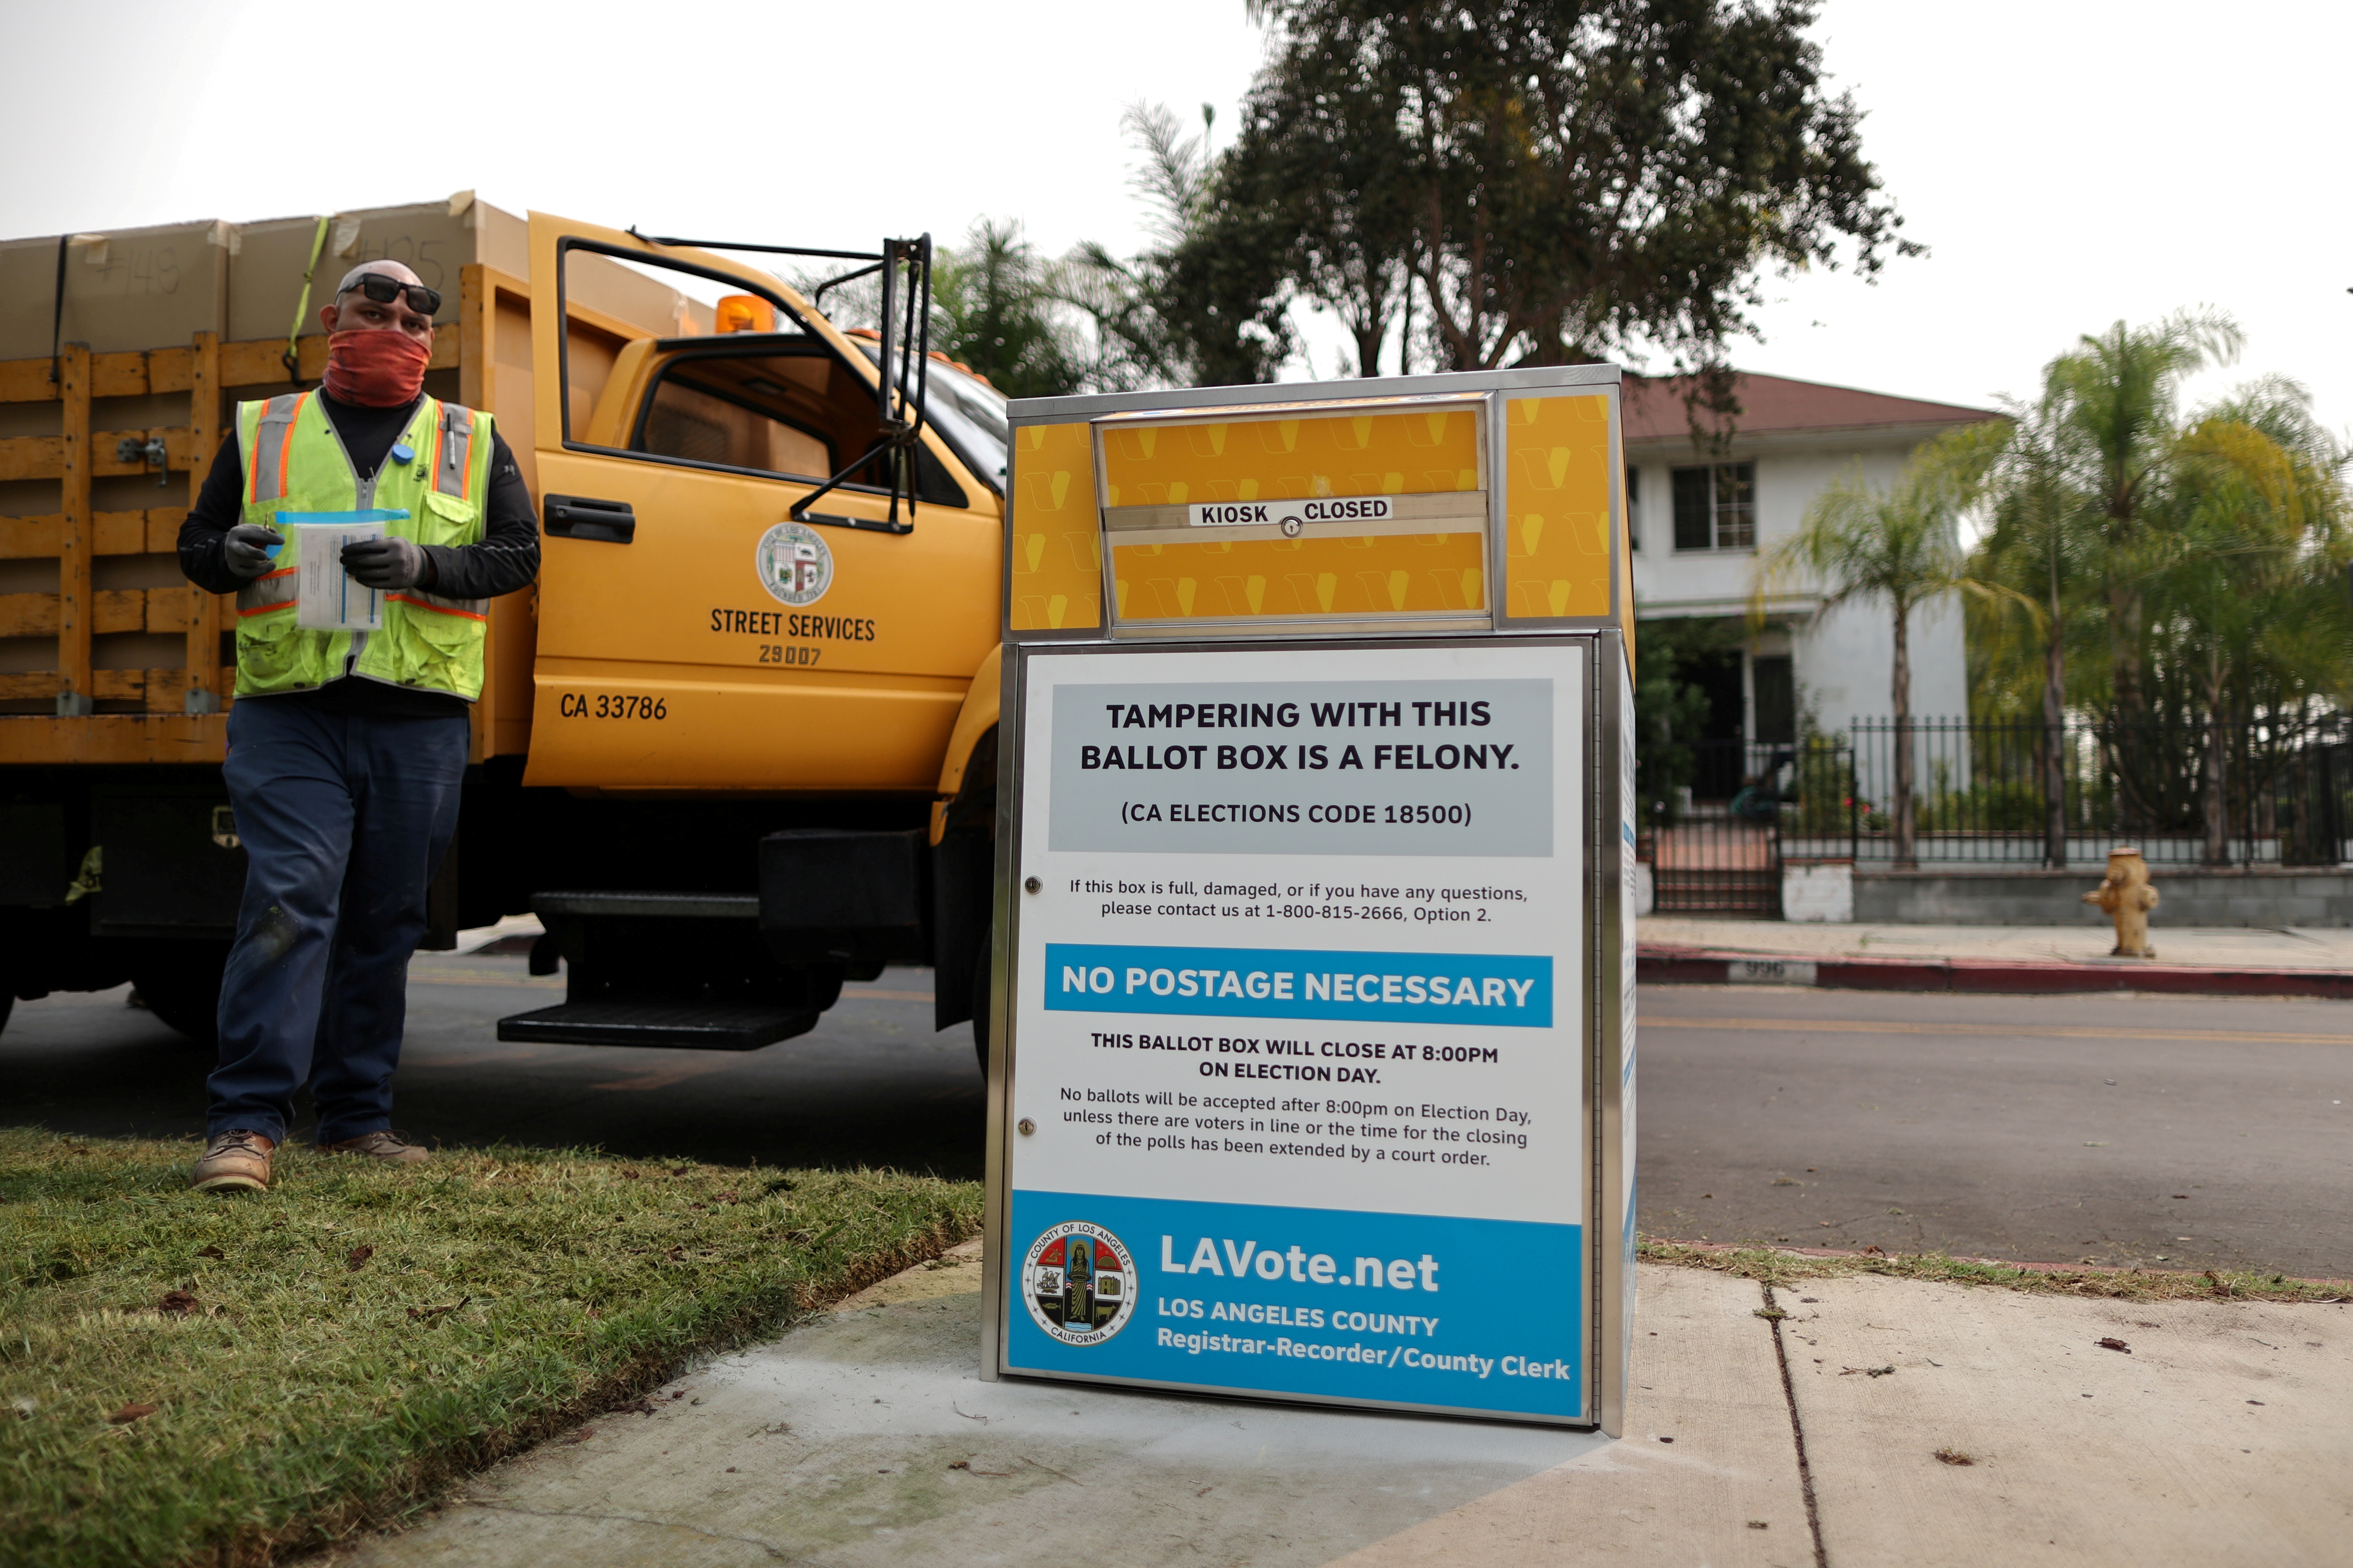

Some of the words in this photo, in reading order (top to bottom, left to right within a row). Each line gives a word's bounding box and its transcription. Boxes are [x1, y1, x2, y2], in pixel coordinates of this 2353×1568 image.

[1202, 506, 1269, 523] KIOSK
[1305, 500, 1388, 520] CLOSED
[711, 608, 782, 635] STREET
[788, 614, 875, 641] SERVICES
[759, 644, 821, 666] 29007
[561, 693, 588, 718] CA
[595, 694, 667, 720] 33786
[1106, 703, 1300, 728] TAMPERING
[1310, 702, 1401, 727] WITH
[1412, 701, 1491, 726] THIS
[1082, 745, 1207, 770] BALLOT
[1217, 745, 1288, 770] BOX
[1299, 745, 1328, 770] IS
[1338, 745, 1364, 769] A
[1374, 744, 1519, 769] FELONY.
[1122, 801, 1162, 824] (CA
[1170, 804, 1300, 823] ELECTIONS
[1309, 804, 1375, 823] CODE
[1384, 803, 1471, 827] 18500)
[1071, 879, 1081, 892] If
[1085, 879, 1113, 893] this
[1119, 880, 1146, 893] box
[1152, 881, 1163, 894] is
[1168, 881, 1198, 897] full,
[1204, 882, 1281, 900] damaged,
[1287, 886, 1304, 897] or
[1310, 883, 1320, 897] if
[1325, 887, 1354, 901] you
[1361, 884, 1399, 898] have
[1405, 888, 1435, 902] any
[1441, 886, 1527, 903] questions,
[1102, 901, 1152, 917] please
[1157, 903, 1216, 916] contact
[1222, 907, 1239, 917] us
[1245, 905, 1260, 917] at
[1266, 904, 1407, 922] 1-800-815-2666,
[1414, 907, 1470, 924] Option
[1477, 908, 1491, 922] 2.
[1063, 966, 1115, 994] NO
[1126, 967, 1294, 1000] POSTAGE
[1305, 973, 1535, 1007] NECESSARY
[1091, 1033, 1133, 1049] THIS
[1139, 1035, 1213, 1052] BALLOT
[1219, 1038, 1260, 1054] BOX
[1265, 1040, 1315, 1056] WILL
[1321, 1041, 1386, 1059] CLOSE
[1391, 1044, 1417, 1060] AT
[1422, 1045, 1498, 1063] 8:00PM
[1199, 1061, 1228, 1077] ON
[1235, 1063, 1330, 1081] ELECTION
[1337, 1067, 1381, 1084] DAY.
[1061, 1087, 1082, 1101] No
[1088, 1088, 1140, 1104] ballots
[1145, 1091, 1173, 1105] will
[1179, 1092, 1197, 1106] be
[1203, 1096, 1275, 1113] accepted
[1281, 1097, 1320, 1112] after
[1326, 1100, 1388, 1119] 8:00pm
[1394, 1106, 1414, 1117] on
[1421, 1104, 1489, 1120] Election
[1496, 1107, 1531, 1126] Day,
[1064, 1109, 1112, 1124] unless
[1117, 1111, 1159, 1126] there
[1164, 1116, 1189, 1128] are
[1195, 1117, 1245, 1130] voters
[1251, 1118, 1264, 1131] in
[1270, 1118, 1300, 1133] line
[1305, 1124, 1323, 1134] or
[1328, 1121, 1355, 1136] the
[1360, 1123, 1398, 1138] time
[1403, 1125, 1427, 1139] for
[1432, 1127, 1460, 1141] the
[1466, 1128, 1527, 1149] closing
[1096, 1131, 1112, 1145] of
[1116, 1132, 1142, 1147] the
[1147, 1135, 1185, 1151] polls
[1191, 1136, 1218, 1151] has
[1224, 1138, 1263, 1153] been
[1269, 1142, 1345, 1158] extended
[1351, 1144, 1370, 1163] by
[1376, 1149, 1385, 1160] a
[1391, 1149, 1435, 1163] court
[1441, 1150, 1490, 1166] order.
[1030, 1228, 1059, 1259] COUNTY
[1062, 1224, 1075, 1233] OF
[1078, 1223, 1095, 1234] LOS
[1097, 1229, 1131, 1266] ANGELES
[1162, 1235, 1438, 1292] LAVote.net
[1158, 1297, 1204, 1319] LOS
[1210, 1301, 1325, 1328] ANGELES
[1332, 1310, 1439, 1336] COUNTY
[1051, 1326, 1107, 1344] CALIFORNIA
[1157, 1327, 1493, 1378] Registrar-Recorder/County
[1501, 1356, 1570, 1380] Clerk
